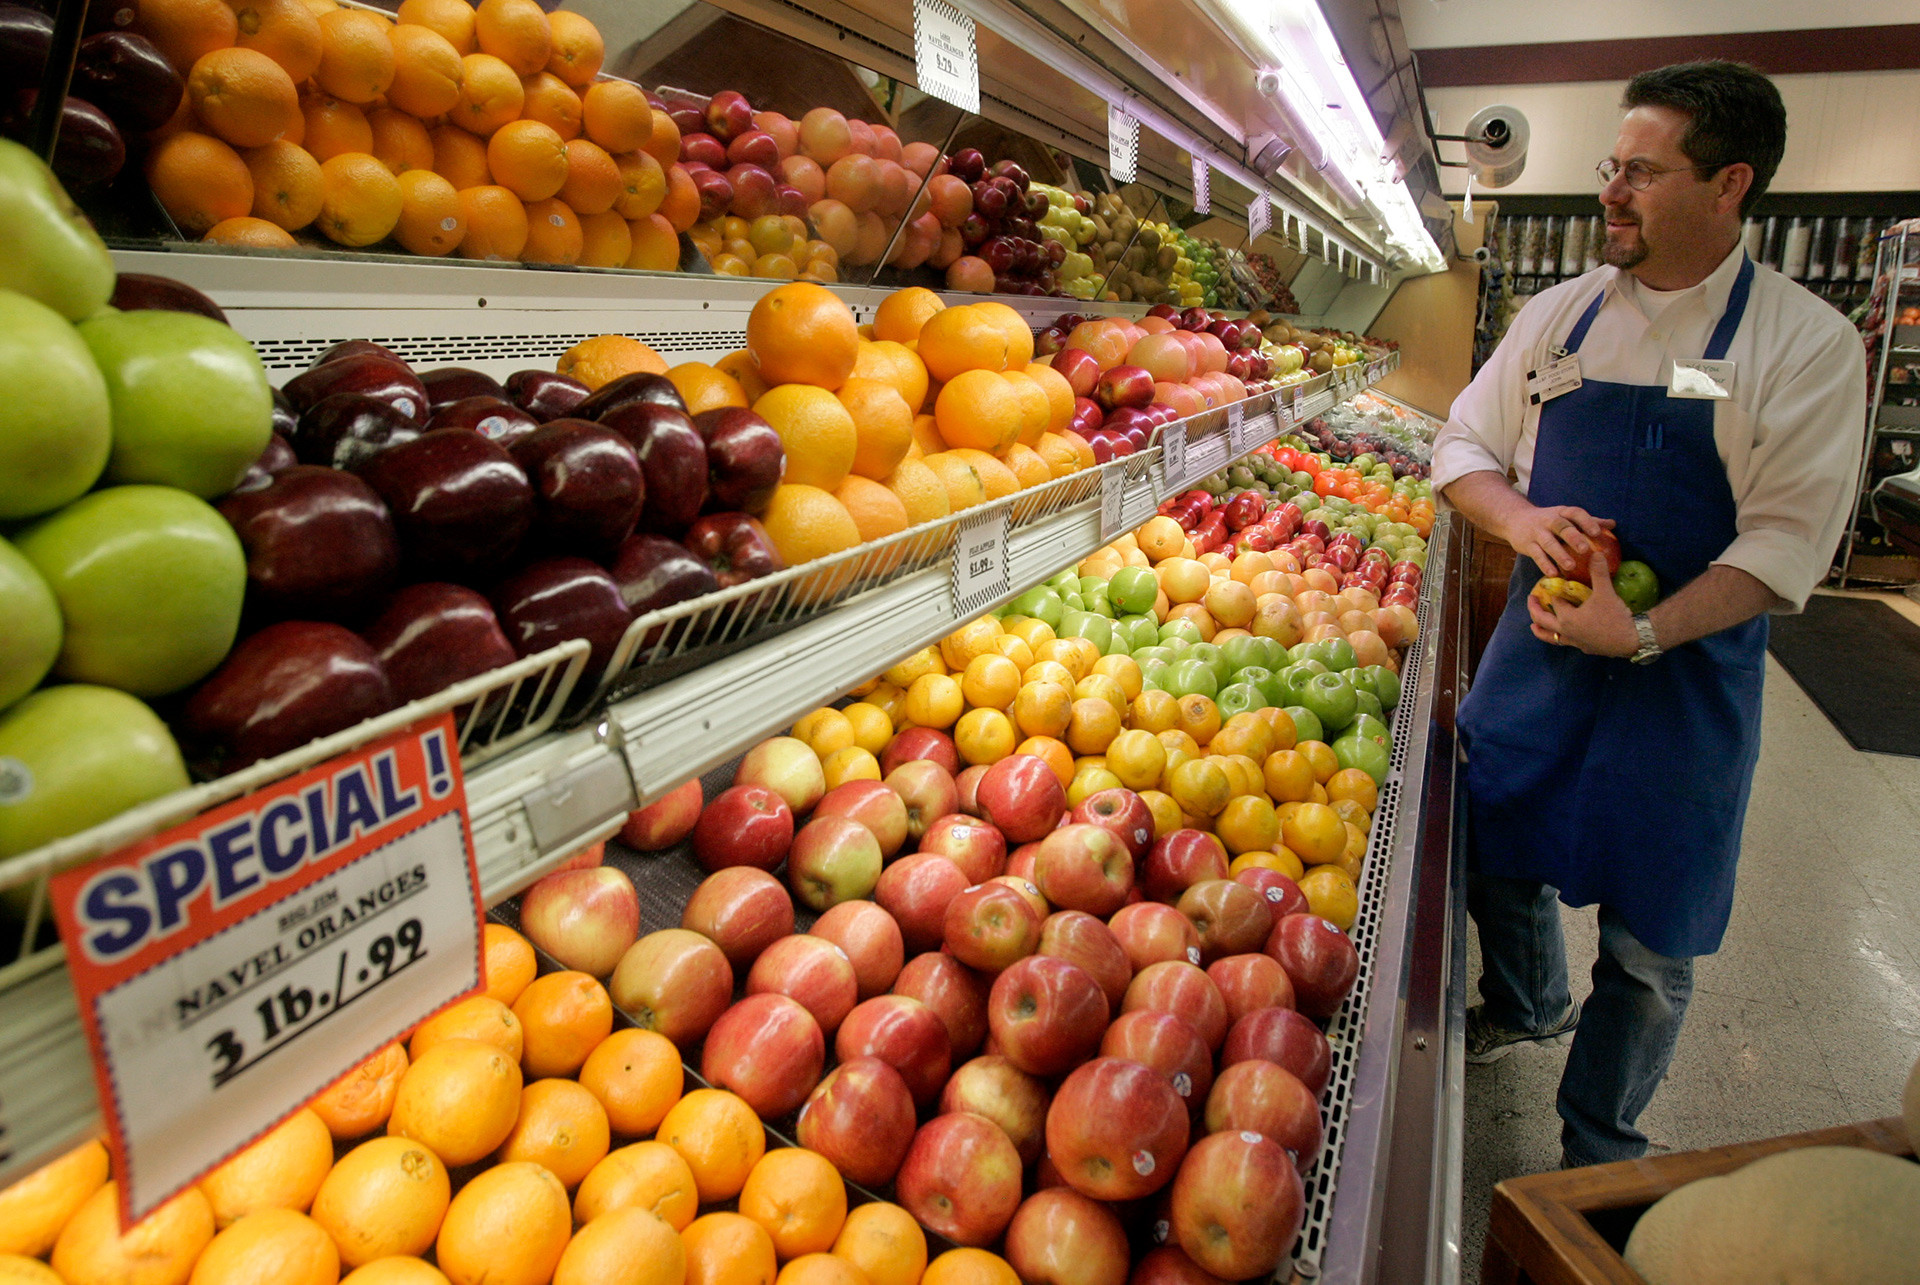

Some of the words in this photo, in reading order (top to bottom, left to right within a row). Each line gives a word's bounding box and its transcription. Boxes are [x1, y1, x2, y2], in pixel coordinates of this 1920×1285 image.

[928, 34, 942, 47] NAVEL
[944, 43, 964, 57] ORANGES
[81, 730, 451, 960] SPECIAL!
[176, 946, 292, 1021] NAVEL
[299, 864, 428, 951] ORANGES
[207, 1029, 245, 1076] 3
